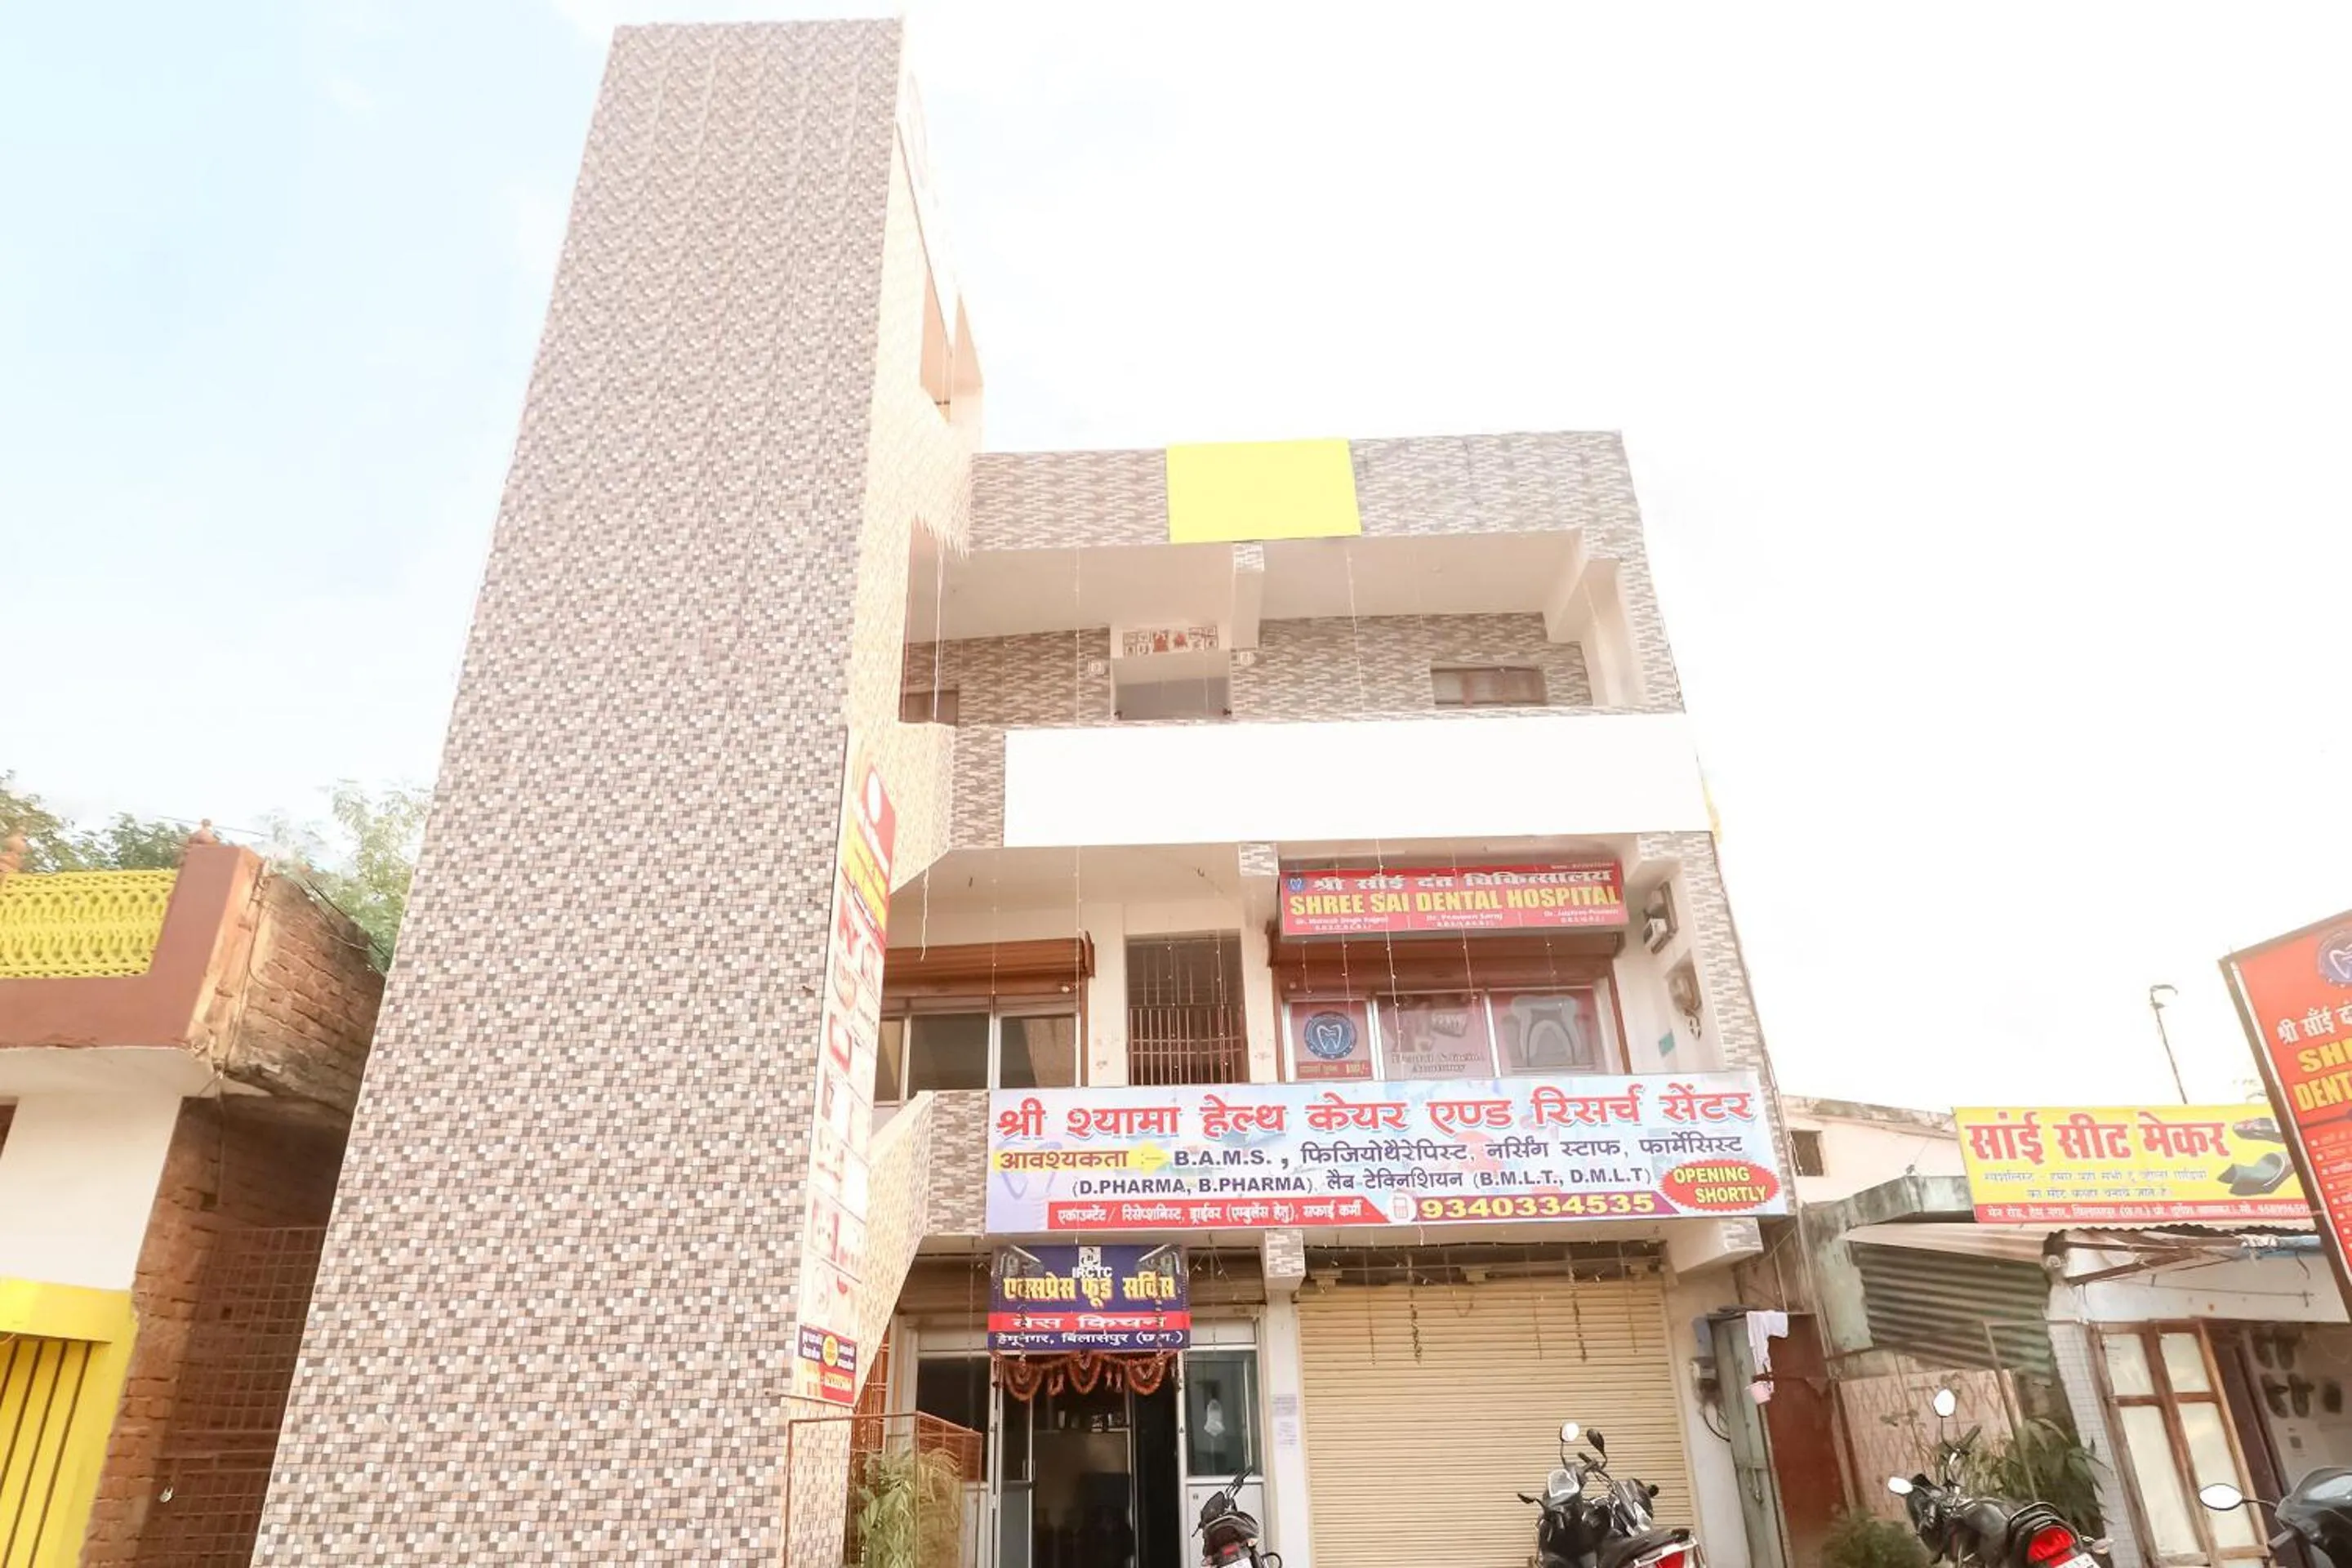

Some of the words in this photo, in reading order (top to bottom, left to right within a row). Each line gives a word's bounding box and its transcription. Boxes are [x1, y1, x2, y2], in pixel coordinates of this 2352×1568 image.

[1313, 877, 1346, 891] श्री
[1463, 871, 1614, 887] चिकित्सालय
[1290, 894, 1365, 915] SHREE
[1370, 892, 1410, 912] SAI
[1415, 890, 1503, 911] DENTAL
[1506, 885, 1620, 908] HOSPITAL
[2277, 1018, 2300, 1045] श्री
[996, 1098, 1045, 1138] श्री
[1067, 1107, 1181, 1138] श्यामा
[1200, 1094, 1286, 1138] हेल्थ
[1305, 1093, 1410, 1134] केयर
[1427, 1098, 1512, 1134] एण्ड
[1531, 1082, 1644, 1127] रिसर्च
[1659, 1083, 1756, 1122] सेंटर
[1000, 1150, 1129, 1169] आवश्यकता
[1486, 1135, 1548, 1160] नर्सिंग
[1561, 1139, 1628, 1158] स्टाफ,
[1639, 1130, 1743, 1155] फार्मेसिस्ट
[1965, 1111, 2043, 1165] सांई
[2054, 1113, 2131, 1160] सीट
[2138, 1111, 2230, 1158] मेकर
[1073, 1178, 1192, 1198] (D.PHARMA,
[1327, 1169, 1354, 1189] लैब
[1363, 1166, 1462, 1189] टेक्निशियन
[1472, 1170, 1563, 1187] (B.M.L.T.,
[1570, 1168, 1650, 1185] D.M.L.T)
[1673, 1167, 1750, 1184] OPENING
[1420, 1192, 1656, 1218] 9340334535
[1695, 1186, 1767, 1204] SHORTLY
[1072, 1267, 1112, 1279] IRCTC
[1003, 1272, 1076, 1299] एक्सप्रेस
[1080, 1276, 1112, 1308] फूड
[1122, 1272, 1176, 1299] सर्विस
[1062, 1332, 1129, 1346] बिलासपुर
